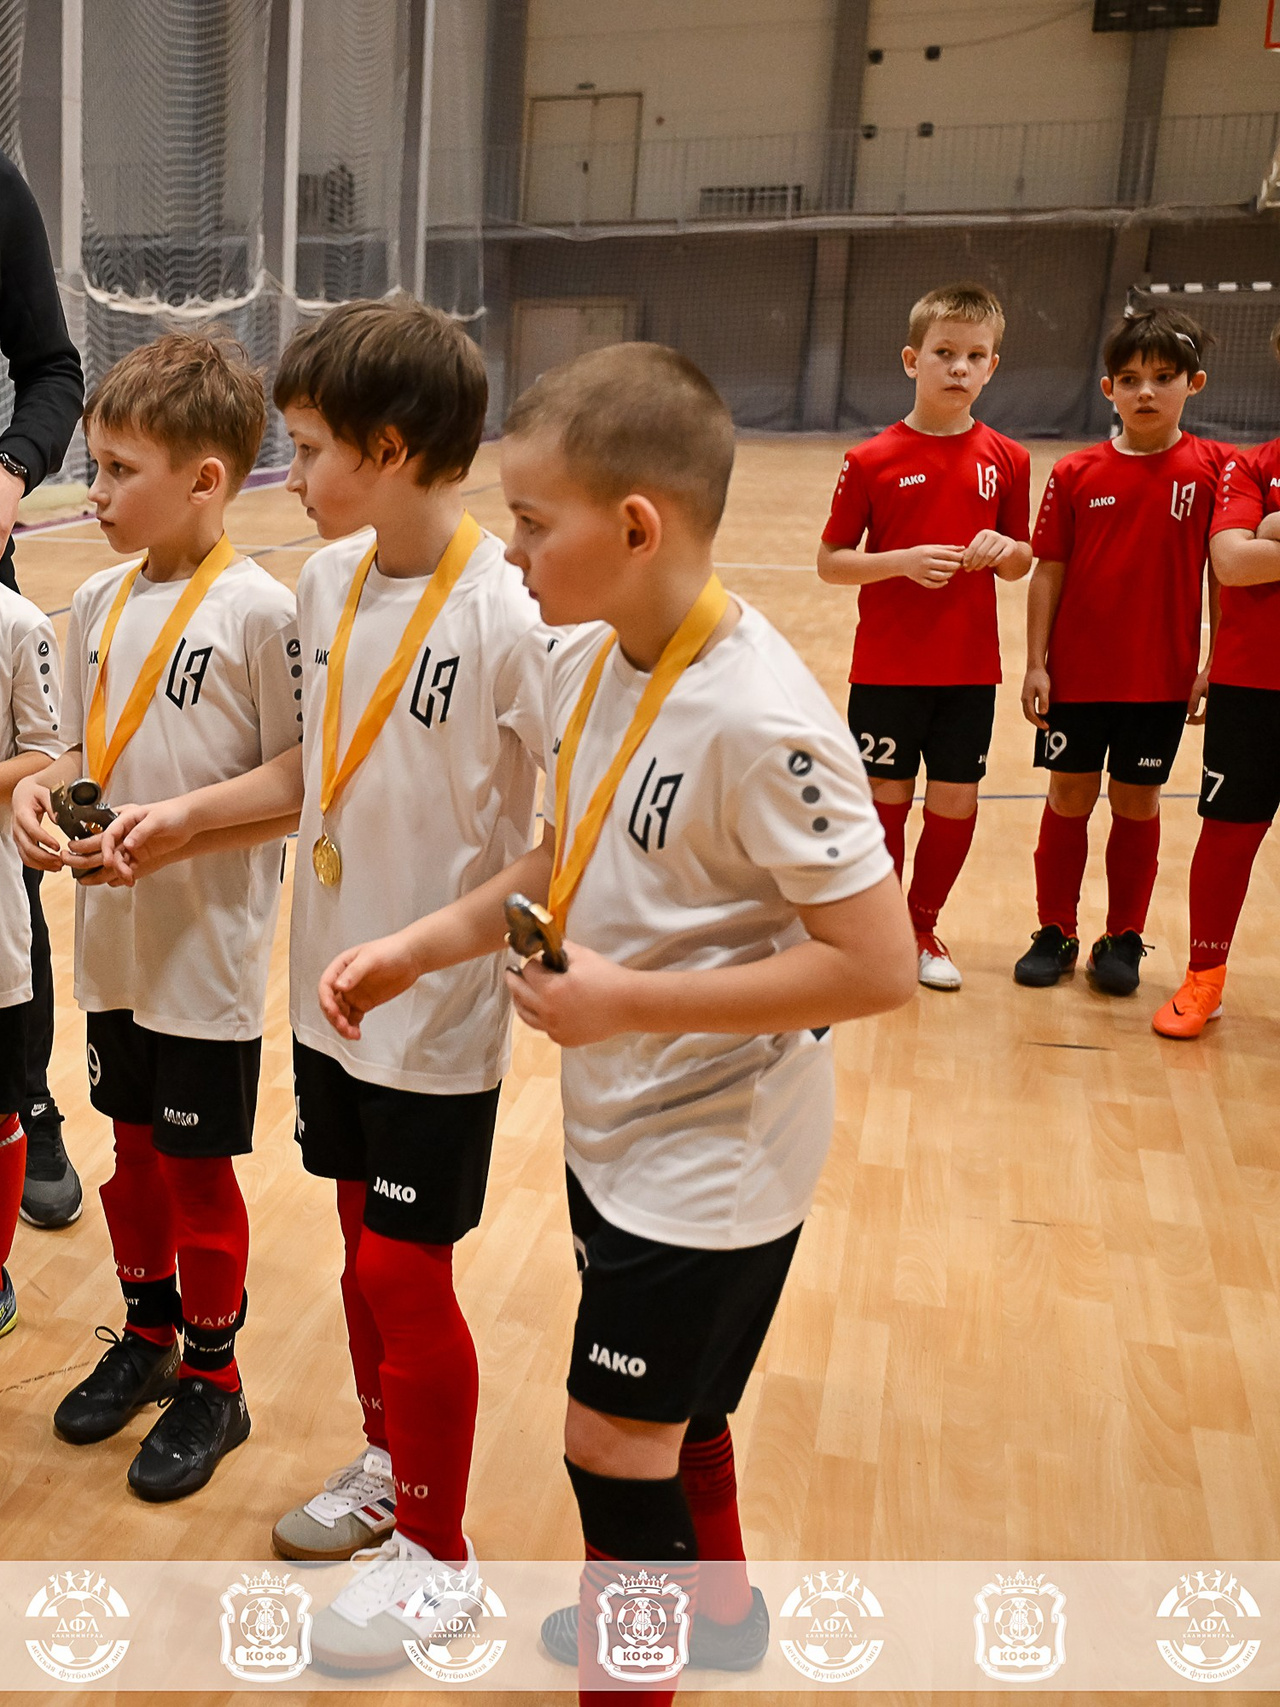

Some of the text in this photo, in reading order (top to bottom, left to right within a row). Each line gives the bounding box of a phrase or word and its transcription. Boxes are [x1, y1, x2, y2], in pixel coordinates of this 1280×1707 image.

[899, 474, 926, 487] JAKO
[1089, 496, 1116, 508] JAKO
[315, 649, 330, 665] JAK
[860, 733, 896, 766] 22
[1045, 731, 1067, 760] 19
[1138, 757, 1162, 767] JAKO
[1191, 939, 1228, 950] JAKO
[163, 1106, 199, 1126] JAKO
[373, 1176, 417, 1204] JAKO
[191, 1310, 237, 1327] JAKO
[588, 1343, 647, 1378] JAKO
[360, 1394, 382, 1411] AK
[393, 1475, 428, 1499] AKO
